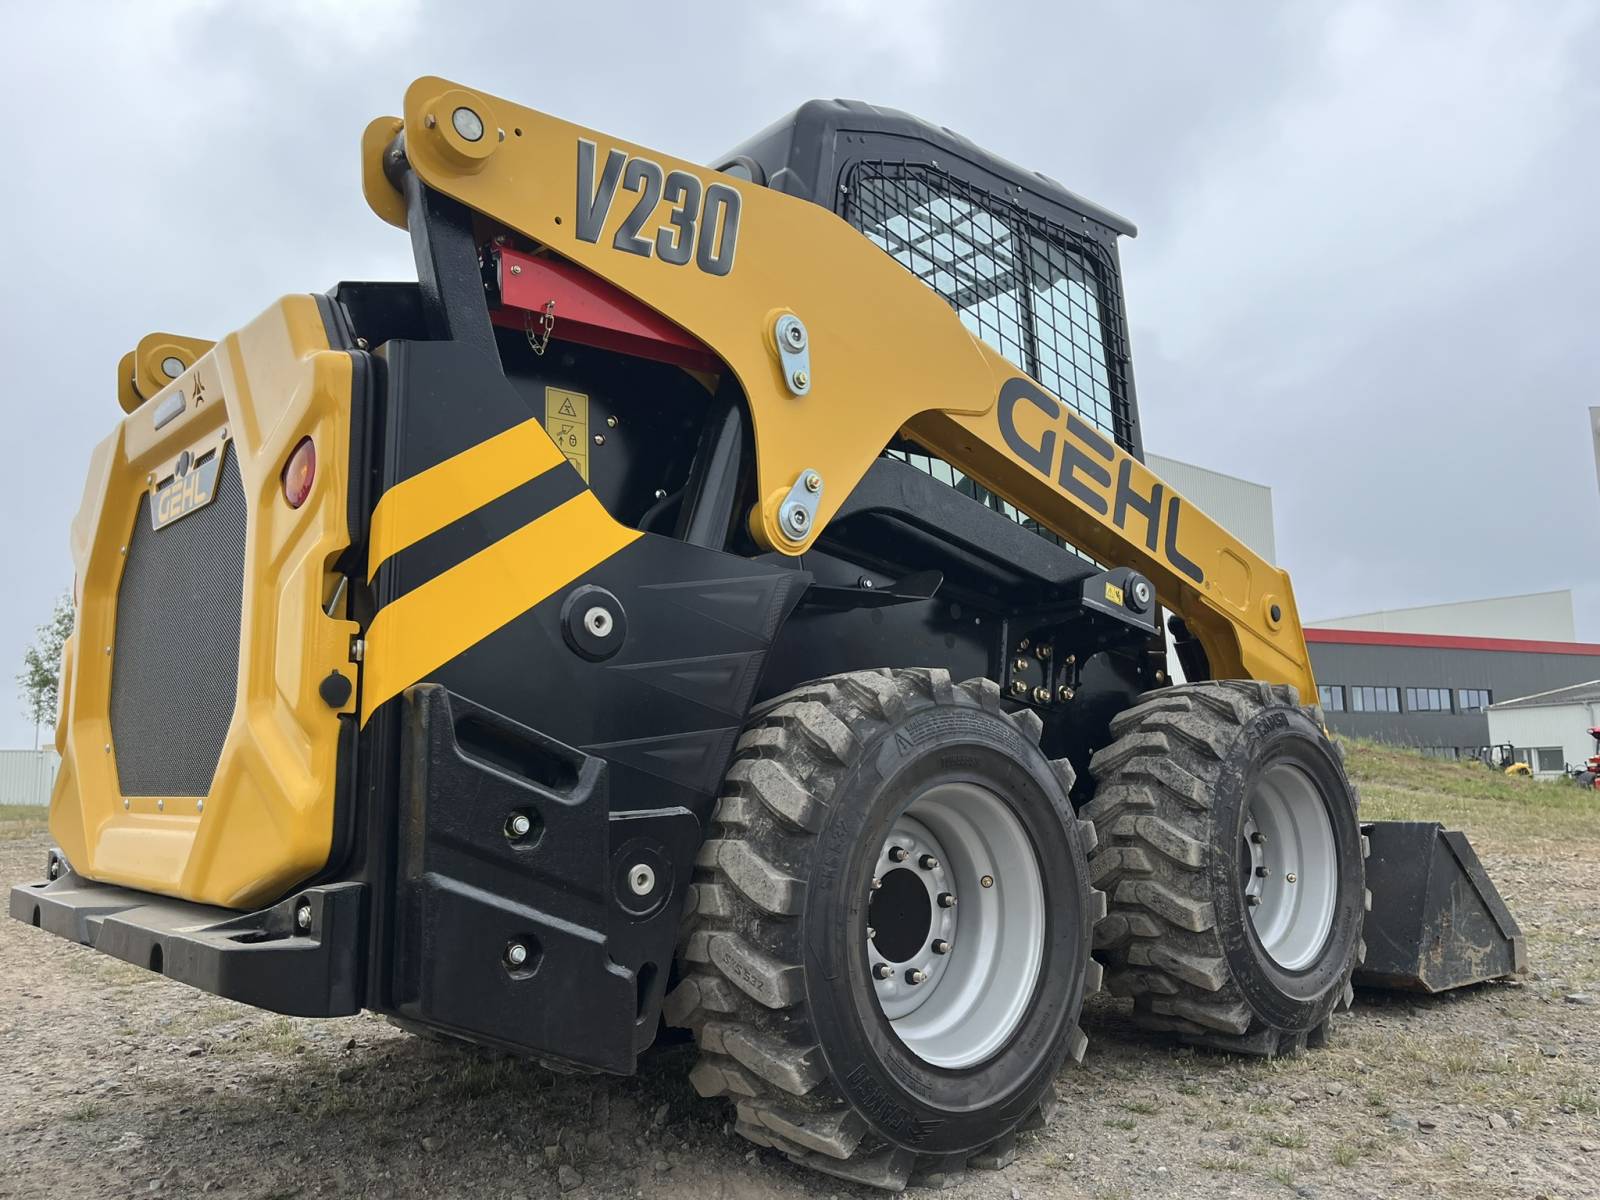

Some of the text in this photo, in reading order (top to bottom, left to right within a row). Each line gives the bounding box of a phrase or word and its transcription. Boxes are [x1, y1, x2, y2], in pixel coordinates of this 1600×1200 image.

[576, 137, 743, 277] V230
[158, 471, 208, 525] GEHL
[997, 377, 1204, 584] GEHL
